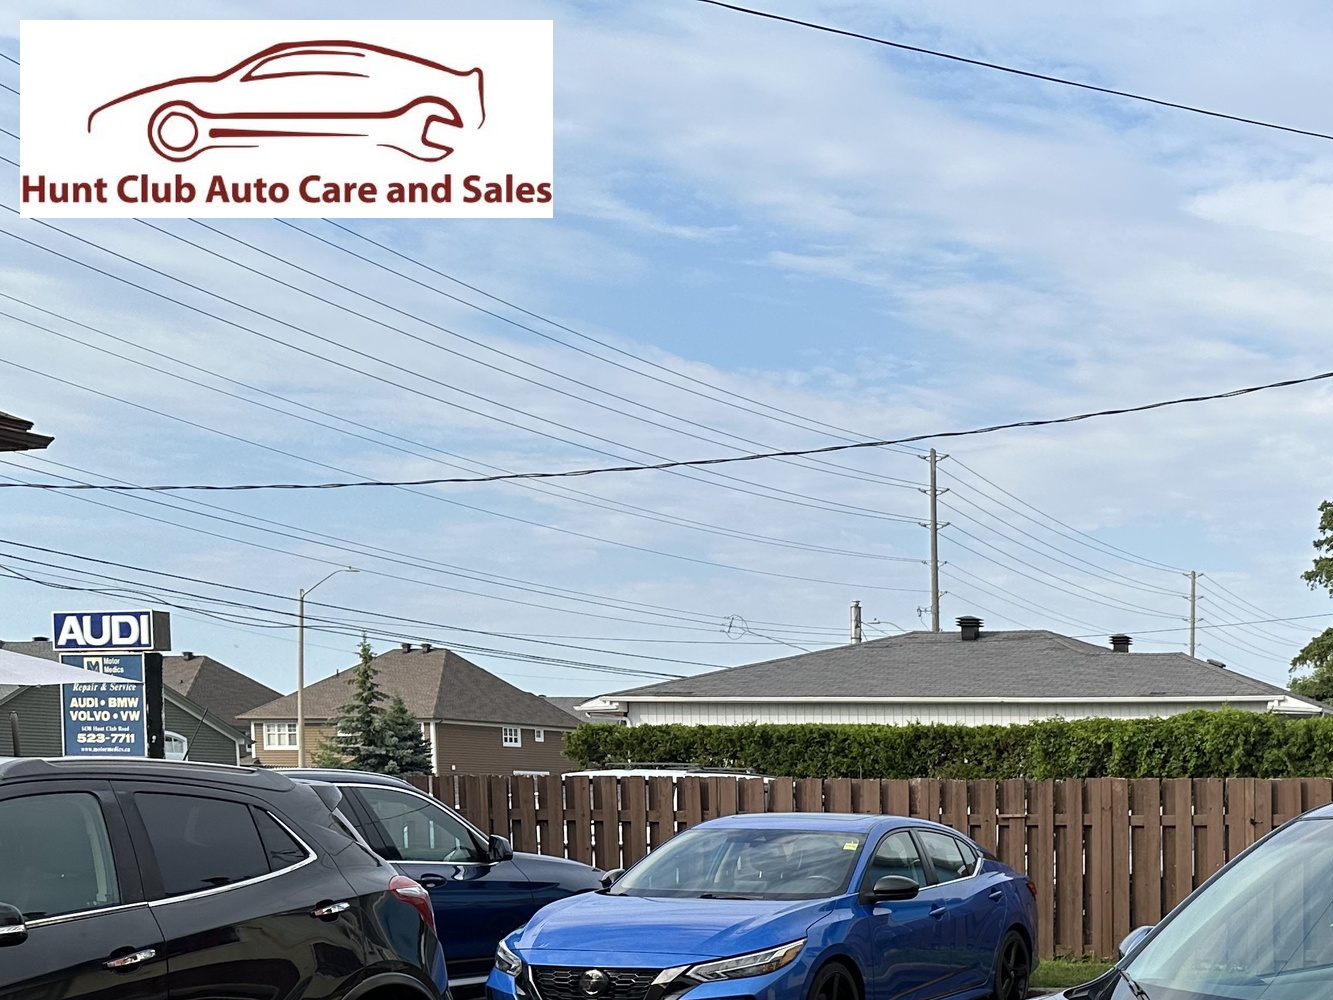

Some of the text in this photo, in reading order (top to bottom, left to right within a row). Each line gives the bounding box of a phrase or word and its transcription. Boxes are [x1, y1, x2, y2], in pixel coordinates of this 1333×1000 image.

[57, 614, 150, 646] AUDI
[103, 657, 121, 665] Motor
[72, 682, 99, 693] Repair
[109, 682, 137, 692] Service
[70, 697, 139, 708] AUDI BMW
[69, 710, 141, 721] VOLVO VW
[77, 733, 135, 743] 523-7711
